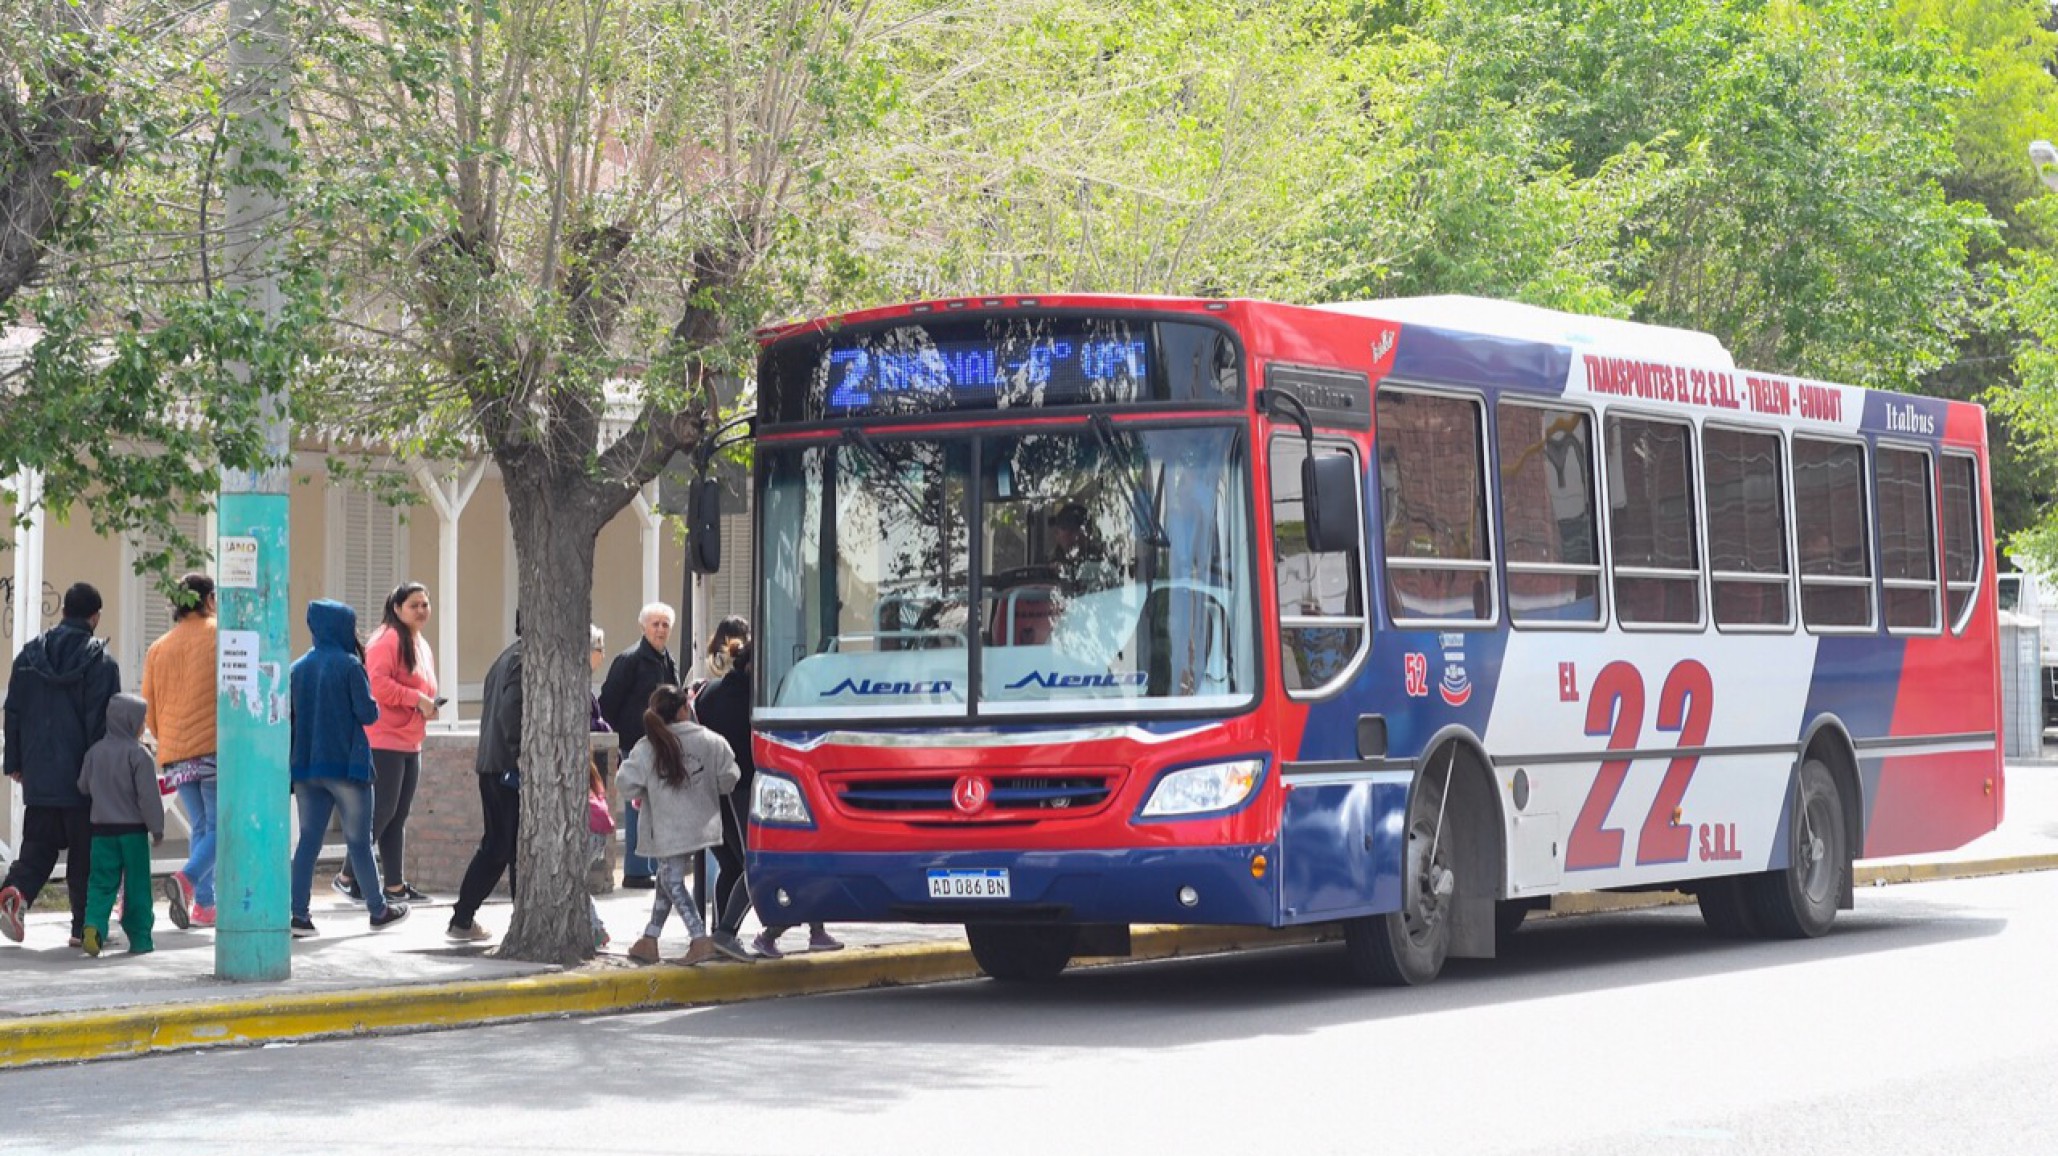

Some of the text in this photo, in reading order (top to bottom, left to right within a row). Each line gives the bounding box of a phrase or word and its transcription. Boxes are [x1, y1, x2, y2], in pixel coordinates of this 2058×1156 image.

[829, 349, 869, 407] 2
[1583, 354, 1675, 402] TRANSPORTES
[1675, 366, 1690, 404] EL
[1690, 368, 1708, 405] 22
[1746, 376, 1790, 416] TRELEW
[1798, 384, 1842, 422] CHUBUT
[1885, 403, 1935, 434] Italbus
[819, 677, 953, 697] Alenco
[1004, 669, 1149, 689] Alenco
[1404, 652, 1429, 697] 52
[1558, 661, 1580, 702] EL
[1564, 658, 1714, 872] 22
[933, 878, 1006, 895] AD 086 BN
